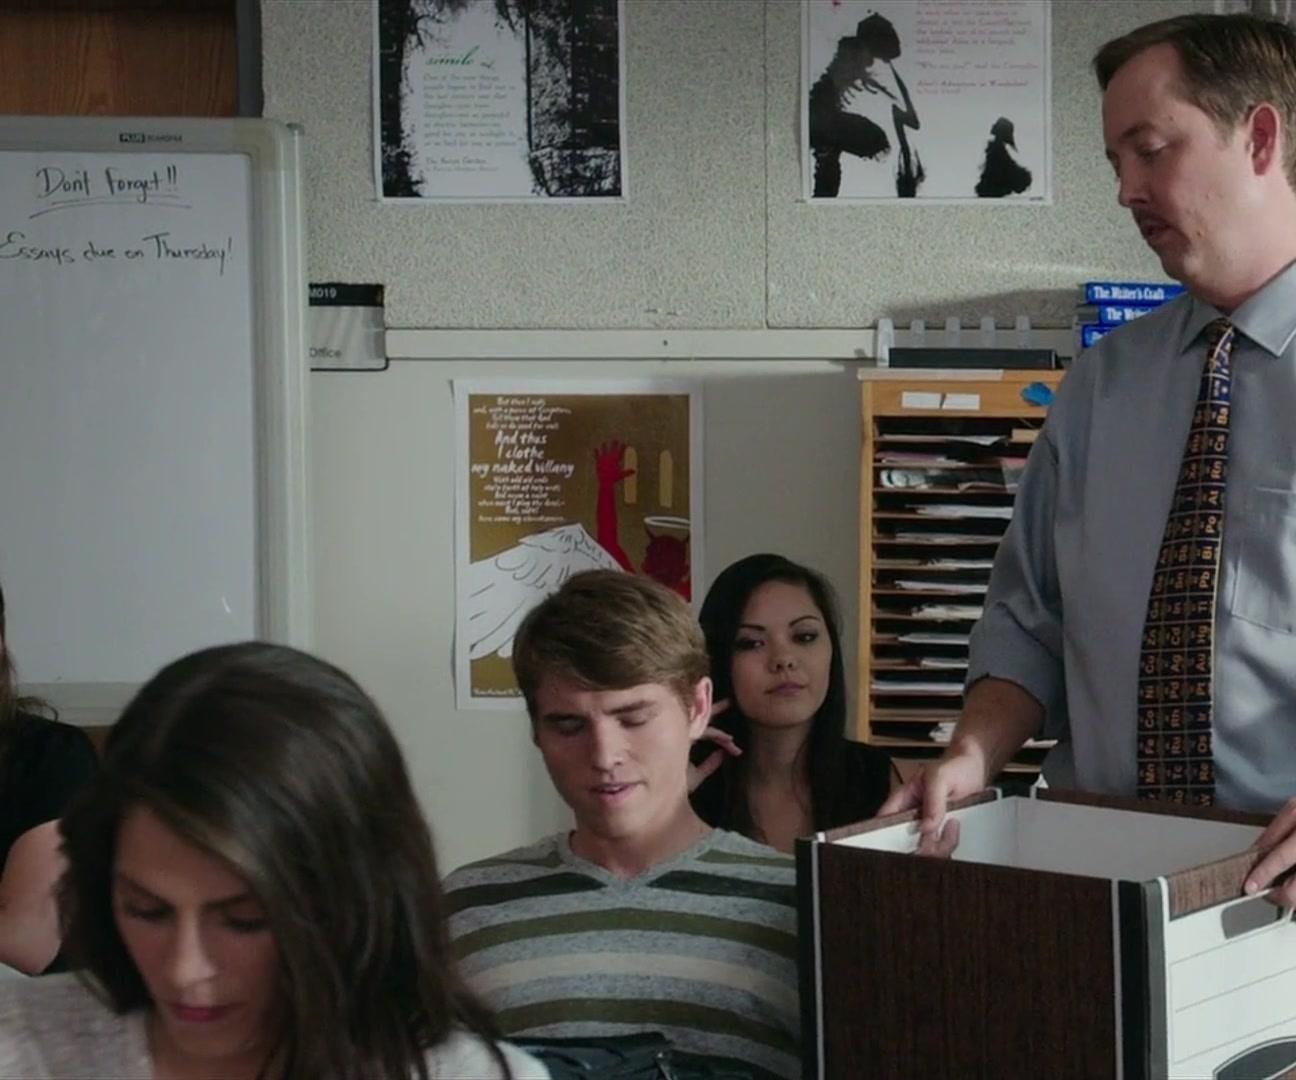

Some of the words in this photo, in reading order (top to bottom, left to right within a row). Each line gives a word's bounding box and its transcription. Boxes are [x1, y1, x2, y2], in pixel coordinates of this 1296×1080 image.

[0, 232, 76, 265] Essays
[83, 242, 117, 260] due
[124, 249, 144, 260] on
[142, 232, 233, 275] Thursday!
[1093, 285, 1110, 300] The
[495, 430, 519, 446] And
[520, 432, 548, 446] thus
[505, 445, 545, 460] clothe
[492, 459, 535, 474] naked
[1199, 572, 1210, 588] Pb
[1206, 516, 1217, 533] Po
